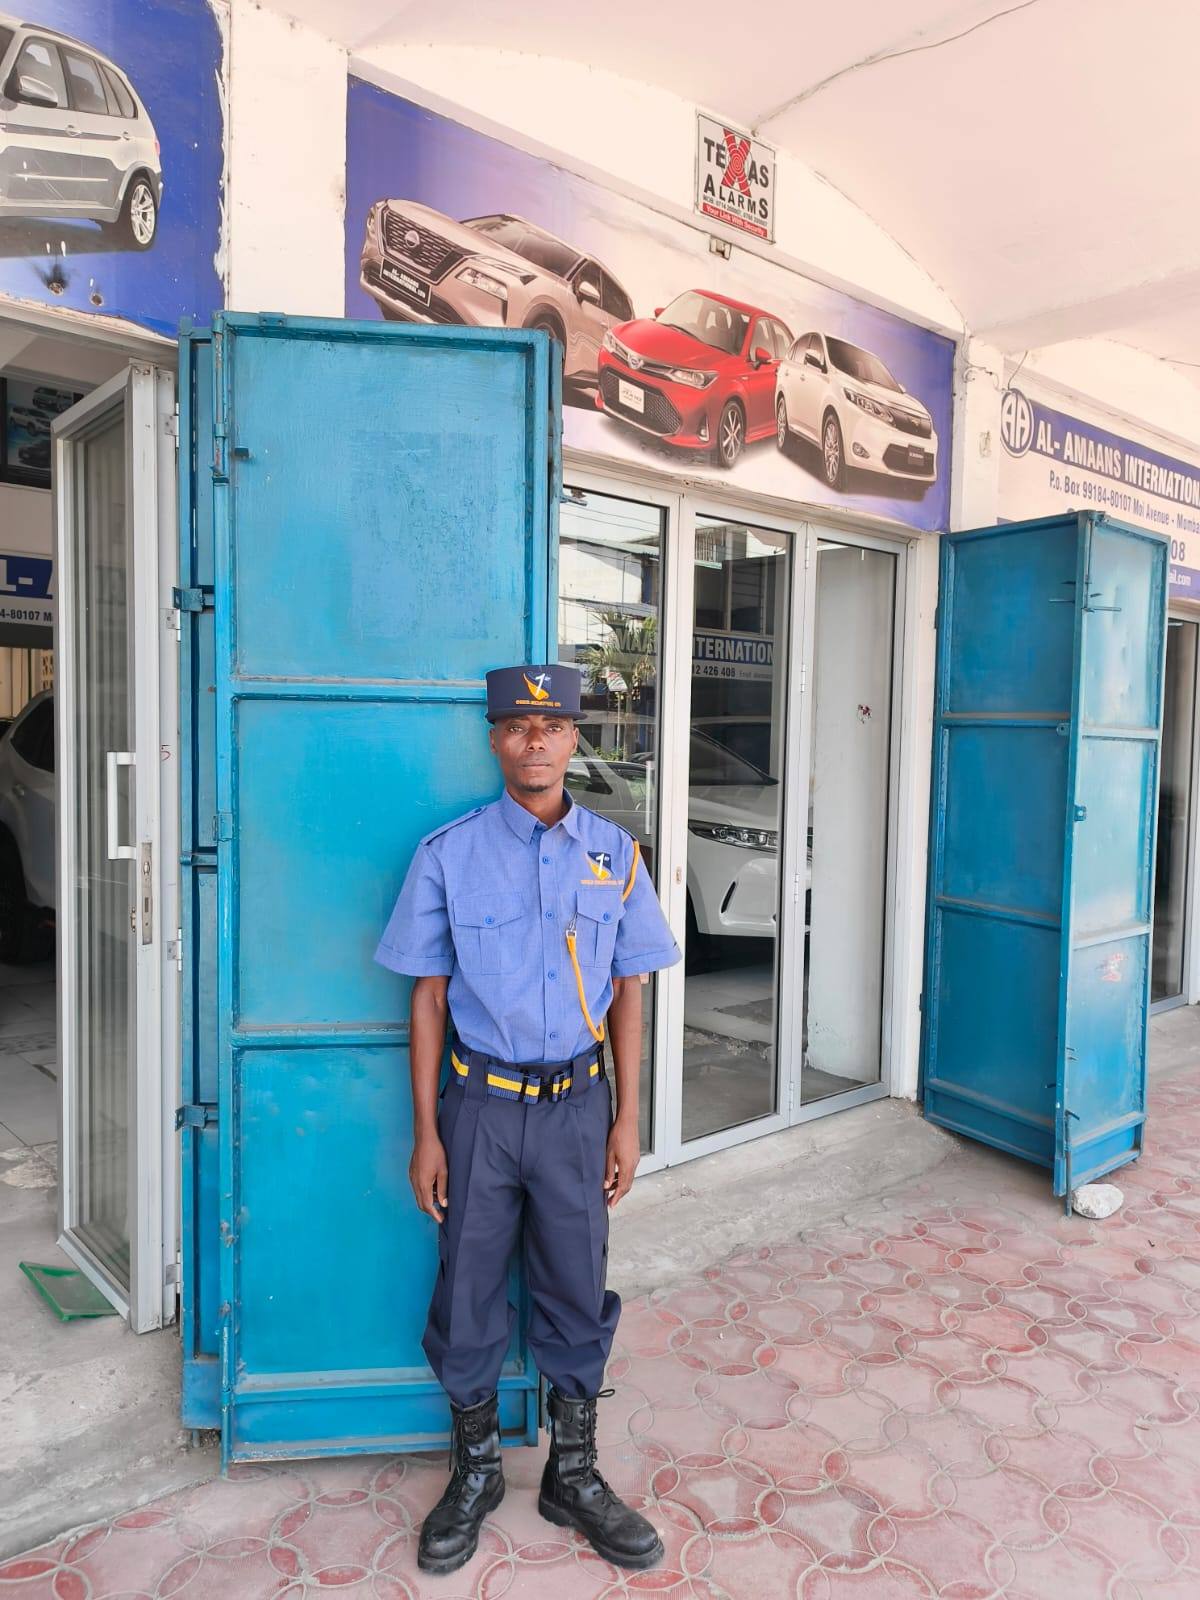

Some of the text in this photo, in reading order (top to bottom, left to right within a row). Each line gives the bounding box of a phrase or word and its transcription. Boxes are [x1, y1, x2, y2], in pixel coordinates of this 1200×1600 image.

[703, 128, 769, 198] TEXAS
[703, 173, 768, 219] ALARMS
[1036, 420, 1060, 455] AL-
[1064, 432, 1121, 478] AMAANS
[1064, 476, 1080, 496] Box
[1082, 481, 1132, 511] 99184-80107
[1146, 504, 1169, 525] Avenue
[692, 635, 773, 665] TERNATION
